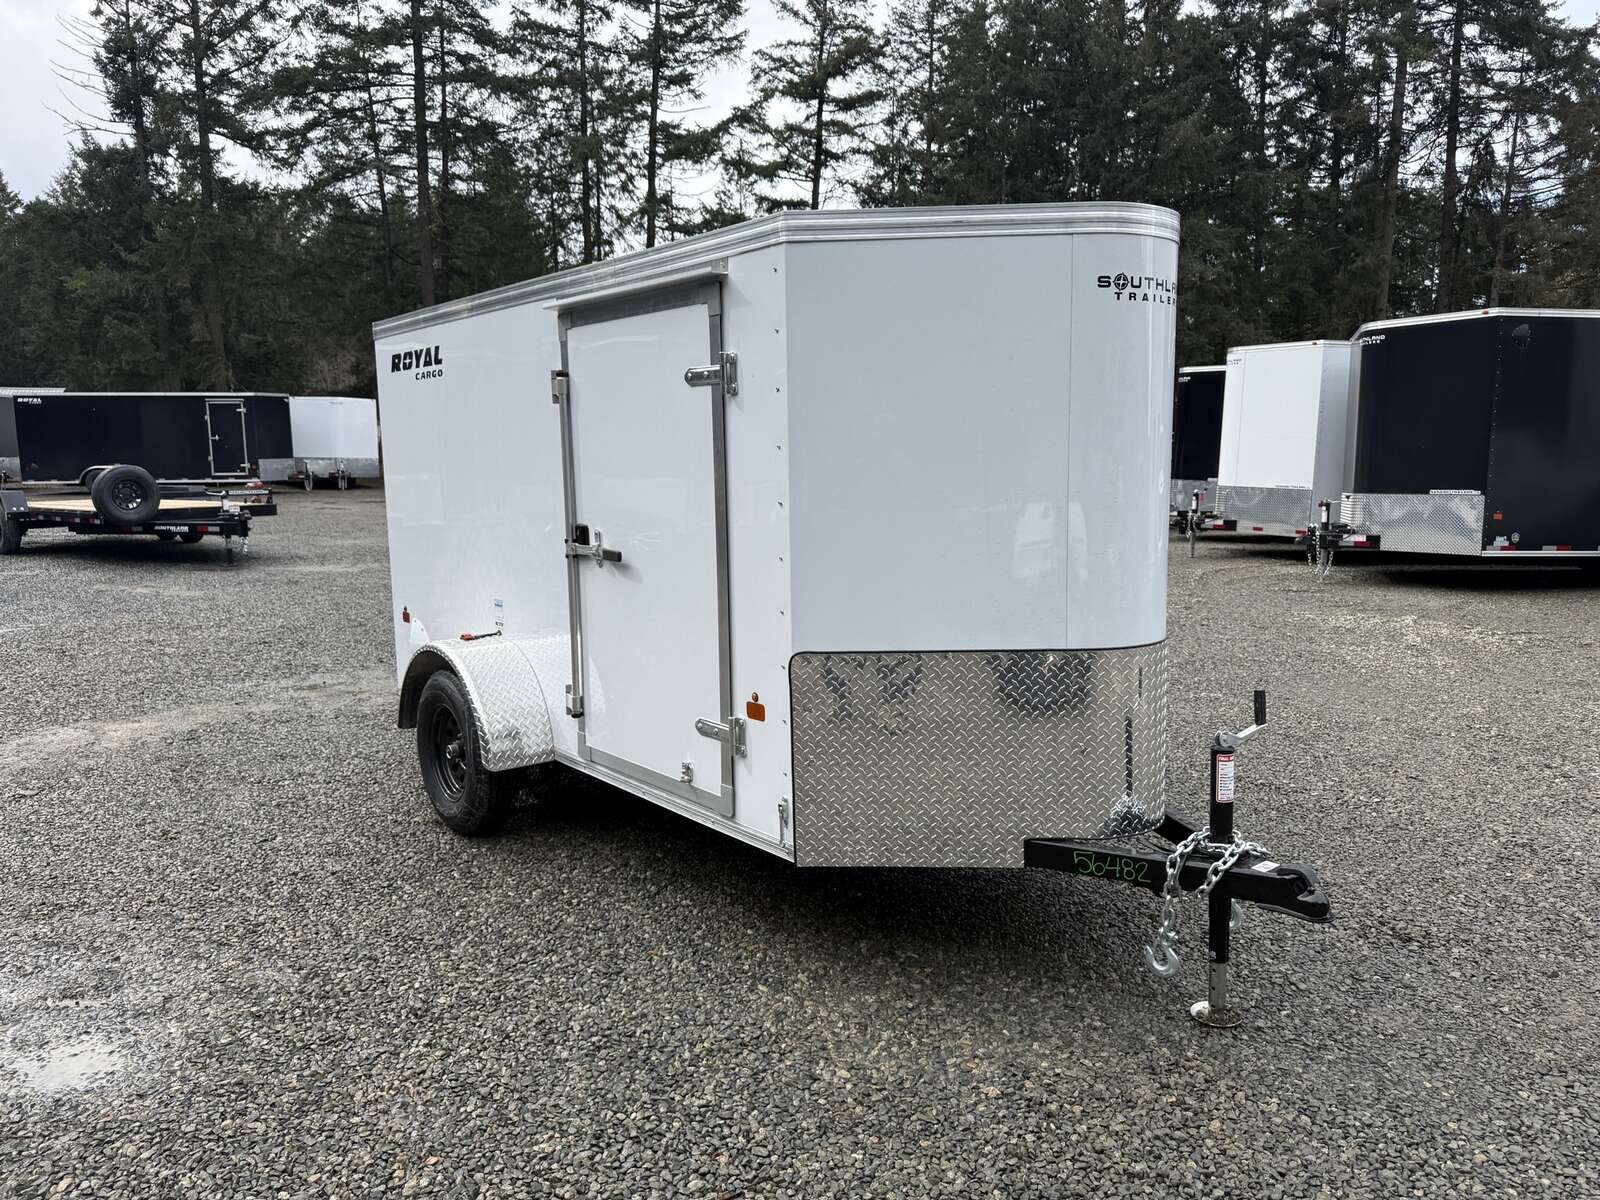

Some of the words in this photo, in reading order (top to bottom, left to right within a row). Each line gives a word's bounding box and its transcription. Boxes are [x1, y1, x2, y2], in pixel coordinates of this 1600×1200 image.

[391, 345, 443, 373] ROYAL
[415, 369, 443, 380] CARGO
[1073, 850, 1152, 883] 56482
